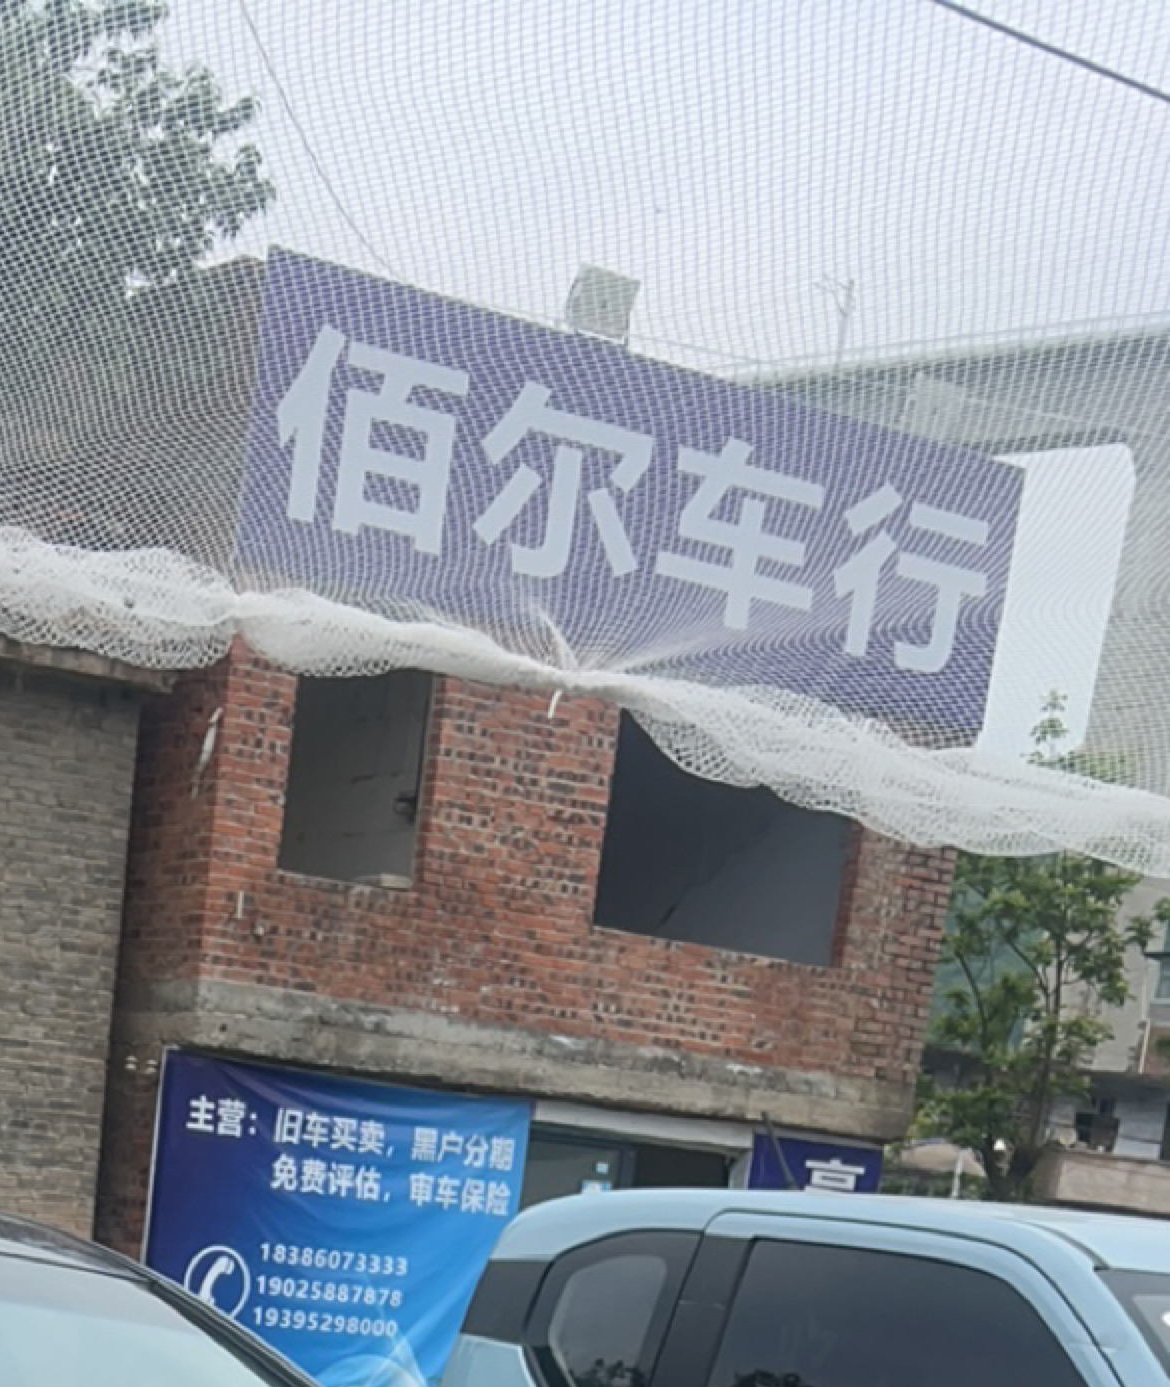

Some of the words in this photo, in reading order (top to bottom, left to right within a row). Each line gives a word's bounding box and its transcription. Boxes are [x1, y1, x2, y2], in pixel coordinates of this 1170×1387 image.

[276, 325, 989, 674] 佰尔车行
[260, 1242, 408, 1277] 18386073333
[256, 1275, 403, 1308] 19025887878
[253, 1306, 399, 1338] 19395298000
